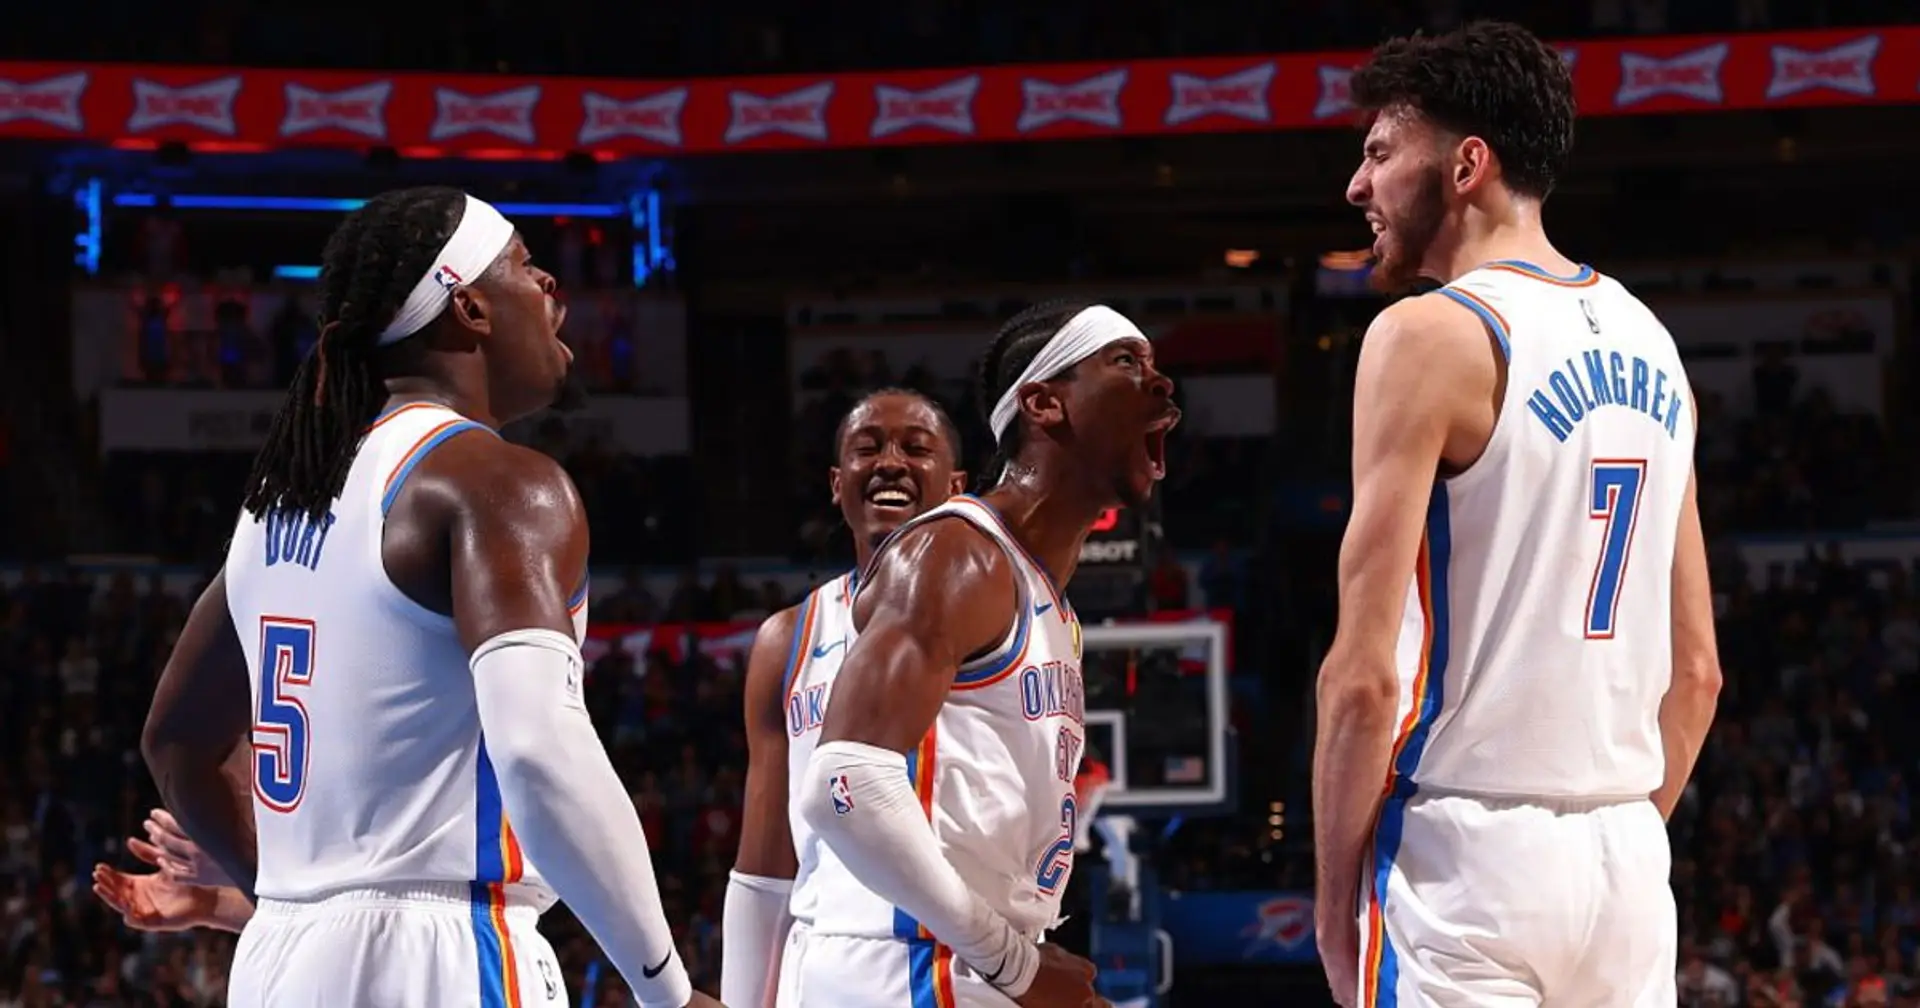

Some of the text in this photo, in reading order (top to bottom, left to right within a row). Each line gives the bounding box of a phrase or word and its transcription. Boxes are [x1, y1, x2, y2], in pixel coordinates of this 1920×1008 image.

[1527, 349, 1682, 443] HOLMGREN
[1584, 458, 1647, 639] 7
[252, 615, 316, 813] 5
